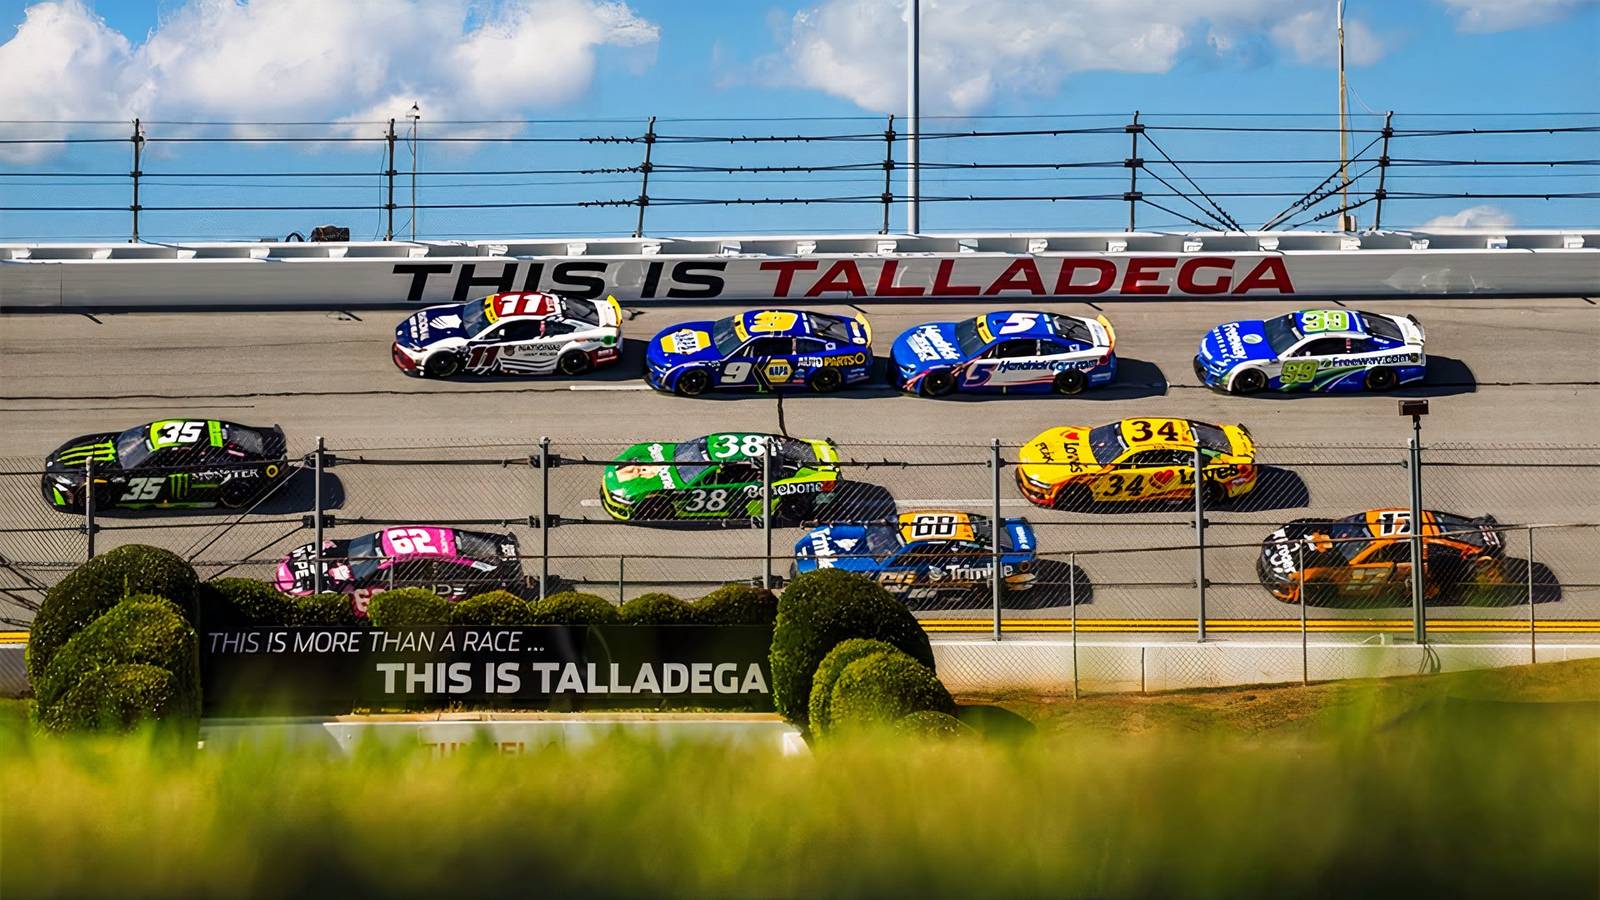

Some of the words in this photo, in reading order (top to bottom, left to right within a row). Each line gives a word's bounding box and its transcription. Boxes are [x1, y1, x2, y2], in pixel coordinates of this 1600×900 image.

[392, 261, 608, 301] THIS
[640, 261, 727, 299] IS
[758, 257, 1297, 297] TALLADEGA
[500, 294, 543, 316] 11
[1000, 312, 1040, 335] 5
[466, 345, 501, 370] 11
[797, 356, 823, 368] AUTO
[824, 356, 854, 368] PARTS
[720, 361, 752, 384] 9
[963, 362, 999, 387] 5
[157, 421, 205, 443] 35
[1131, 420, 1179, 442] 34
[714, 434, 767, 458] 38
[192, 468, 259, 484] MONSTER
[1103, 474, 1144, 497] 34
[120, 477, 167, 501] 35
[685, 489, 729, 512] 38
[914, 515, 956, 537] 60
[387, 528, 439, 554] 62
[208, 632, 261, 654] THIS
[266, 632, 288, 653] IS
[293, 631, 363, 653] MORE
[369, 631, 436, 652] THAN
[439, 631, 457, 652] A
[462, 631, 523, 652] RACE
[376, 662, 472, 694] THIS
[485, 662, 521, 694] IS
[532, 662, 769, 694] TALLADEGA
